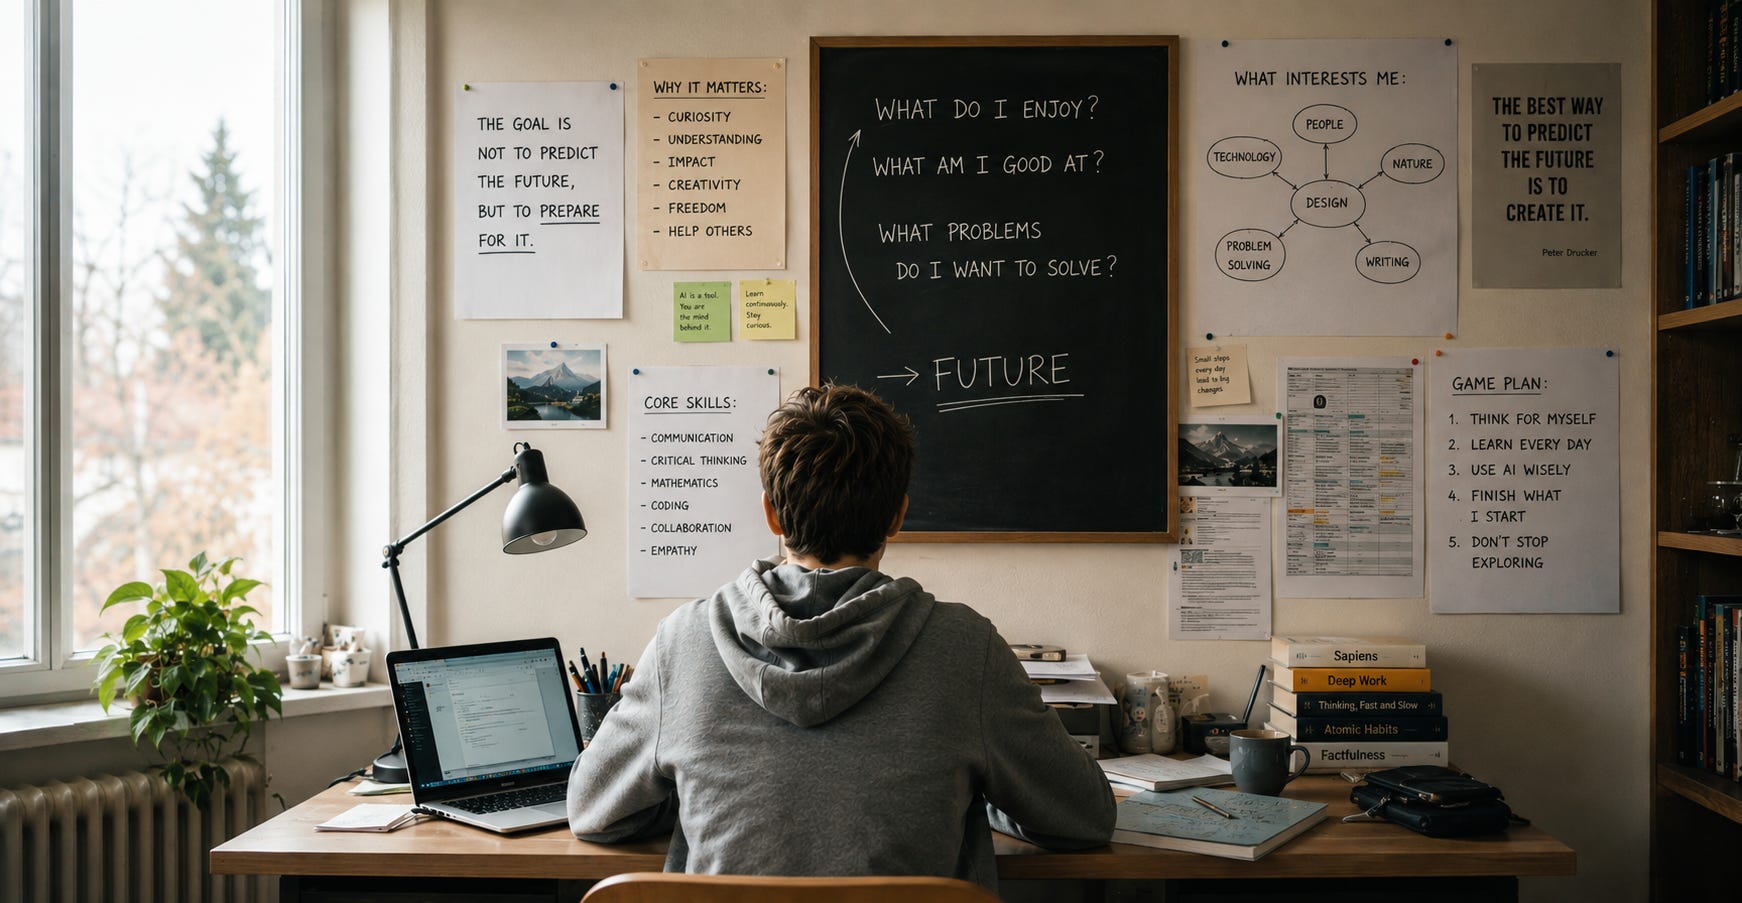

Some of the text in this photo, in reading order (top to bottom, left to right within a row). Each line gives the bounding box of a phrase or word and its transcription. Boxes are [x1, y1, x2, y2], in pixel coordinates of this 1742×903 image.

[1235, 71, 1405, 85] WHAT INTERESTS ME:
[654, 81, 766, 93] WHY IT MATTERS:
[876, 95, 1098, 120] WHAT DO I ENJOY?
[1493, 97, 1603, 115] THE BEST WAY
[668, 112, 731, 122] CURIOSITY
[477, 117, 571, 131] THE GOAL IS
[1307, 119, 1343, 129] PEOPLE
[1502, 124, 1593, 141] TO PREDICT
[669, 134, 762, 144] UNDERSTANDING
[479, 146, 598, 160] NOT TO PREDICT
[1214, 152, 1276, 162] TECHNOLOGY
[669, 157, 715, 167] IMPACT
[1393, 159, 1432, 168] NATURE
[1501, 150, 1594, 168] THE FUTURE
[873, 157, 925, 176] WHAT
[937, 157, 963, 174] AM
[977, 156, 988, 174] I
[1004, 155, 1052, 174] GOOD
[478, 175, 574, 190] THE FUTURE,
[669, 179, 740, 190] CREATIVITY
[1529, 177, 1567, 195] IS TO
[669, 203, 726, 213] FREEDOM
[1307, 197, 1347, 208] DESIGN
[479, 204, 599, 218] BUT TO PREPARE
[1507, 204, 1588, 221] CREATE IT.
[669, 226, 752, 236] HELP OTHERS
[879, 222, 1041, 243] WHAT PROBLEMS
[479, 234, 533, 247] FOR IT.
[1227, 241, 1271, 251] PROBLEM
[1228, 260, 1271, 270] SOLVING
[1366, 257, 1409, 267] WRITING
[896, 262, 919, 280] DO
[930, 261, 941, 279] I
[953, 260, 1005, 278] WANT
[1015, 260, 1036, 276] TO
[933, 353, 1070, 391] FUTURE
[1453, 377, 1547, 391] GAME PLAN:
[645, 396, 736, 409] CORE SKILLS:
[1449, 413, 1596, 425] 1. THINK FOR MYSELF
[651, 433, 733, 442] COMMUNICATION
[1449, 439, 1592, 450] 2. LEARN EVERY DAY
[651, 456, 747, 465] CRITICAL THINKING
[1449, 464, 1570, 476] 3. USE AI WISELY
[652, 479, 718, 488] MATHEMATICS
[1448, 490, 1561, 501] 4. FINISH WHAT
[651, 501, 689, 510] CODING
[1471, 511, 1526, 522] I START
[651, 523, 731, 533] COLLABORATION
[1449, 535, 1548, 548] 5. DON'T STOP
[652, 546, 697, 555] EMPATHY
[1473, 557, 1543, 568] EXPLORING
[1334, 651, 1378, 663] Sapiens
[1328, 675, 1387, 688] Deep Work
[1319, 701, 1357, 712] Thinking,
[1360, 701, 1377, 709] Fast
[1380, 701, 1395, 709] and
[1398, 701, 1418, 709] Slow
[1325, 724, 1360, 734] Atomic
[1365, 724, 1398, 734] Habits
[1322, 749, 1385, 760] Factfulness
